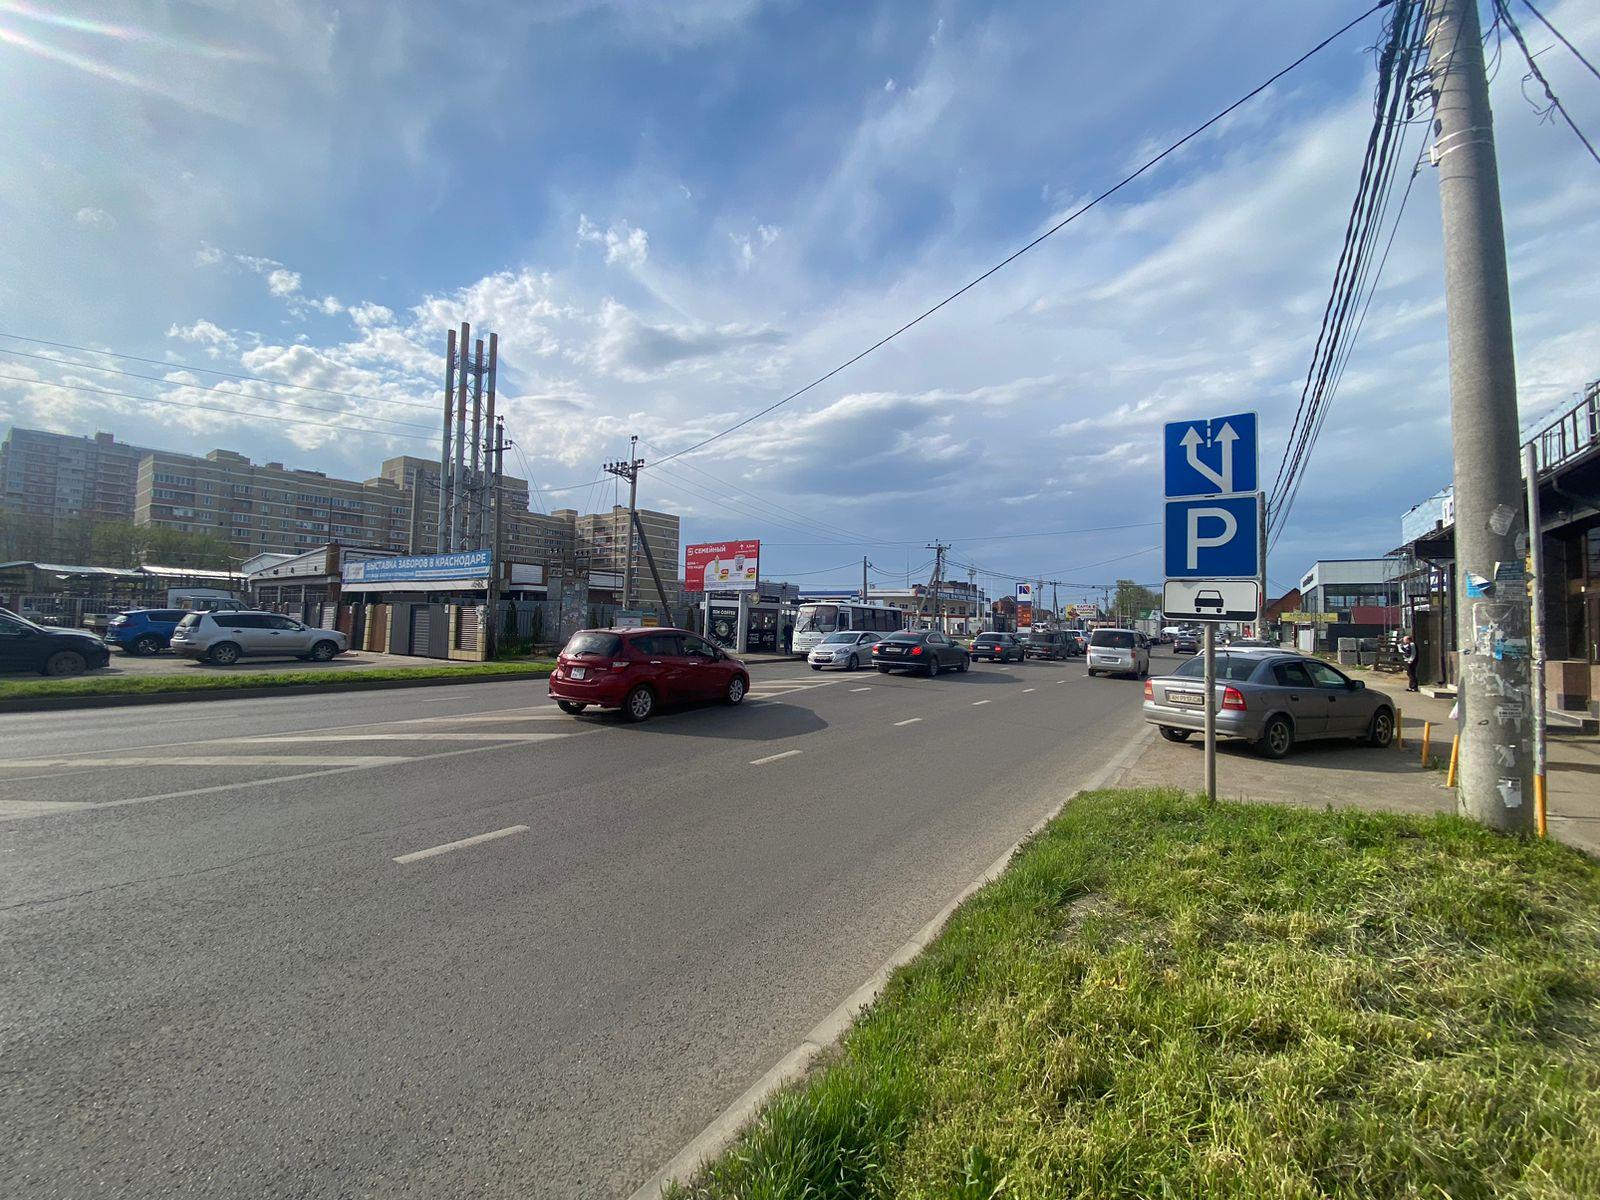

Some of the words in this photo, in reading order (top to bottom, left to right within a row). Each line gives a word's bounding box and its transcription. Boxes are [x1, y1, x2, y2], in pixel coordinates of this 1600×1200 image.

[1187, 508, 1237, 570] P
[694, 545, 726, 554] СЕМЕЙНЫЙ
[366, 560, 397, 570] ВЫСТАВКА
[398, 558, 428, 569] ЗАБОРОВ
[429, 559, 434, 567] В
[435, 553, 486, 567] КРАСНОДАРЕ
